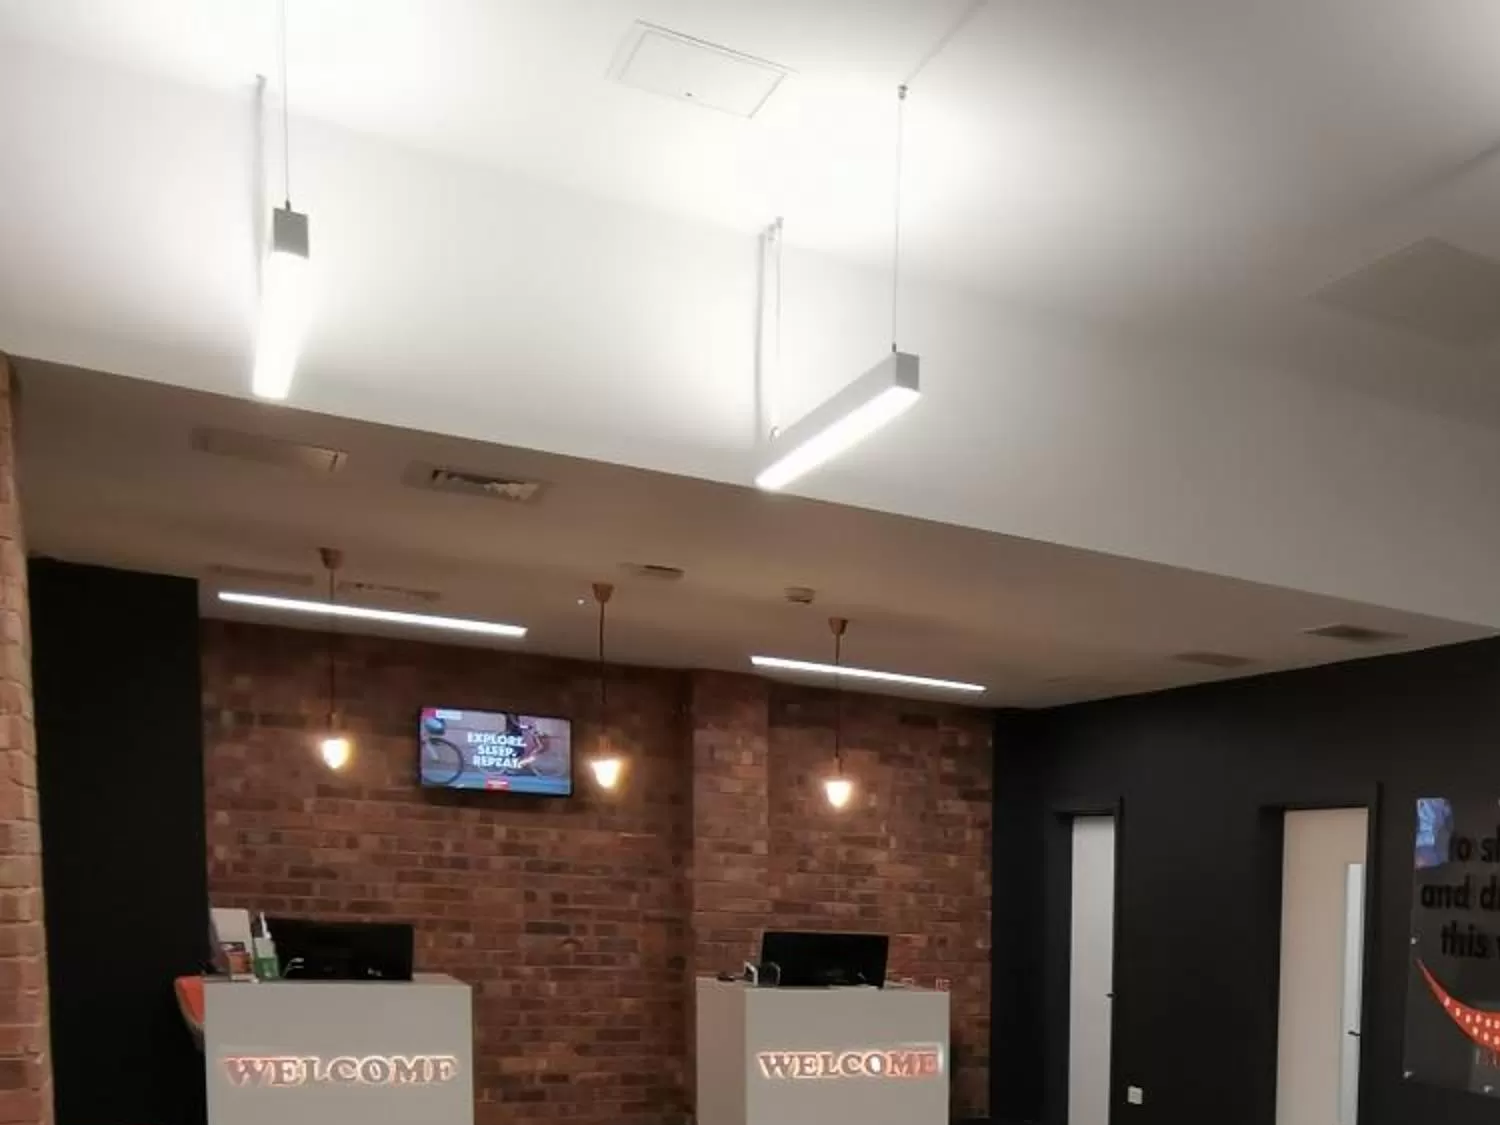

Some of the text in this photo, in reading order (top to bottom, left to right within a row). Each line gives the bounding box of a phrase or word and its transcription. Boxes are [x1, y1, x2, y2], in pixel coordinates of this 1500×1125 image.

[1420, 874, 1470, 910] and
[1440, 919, 1489, 958] this
[222, 1055, 459, 1087] WELCOME
[757, 1050, 941, 1078] WELCOME
